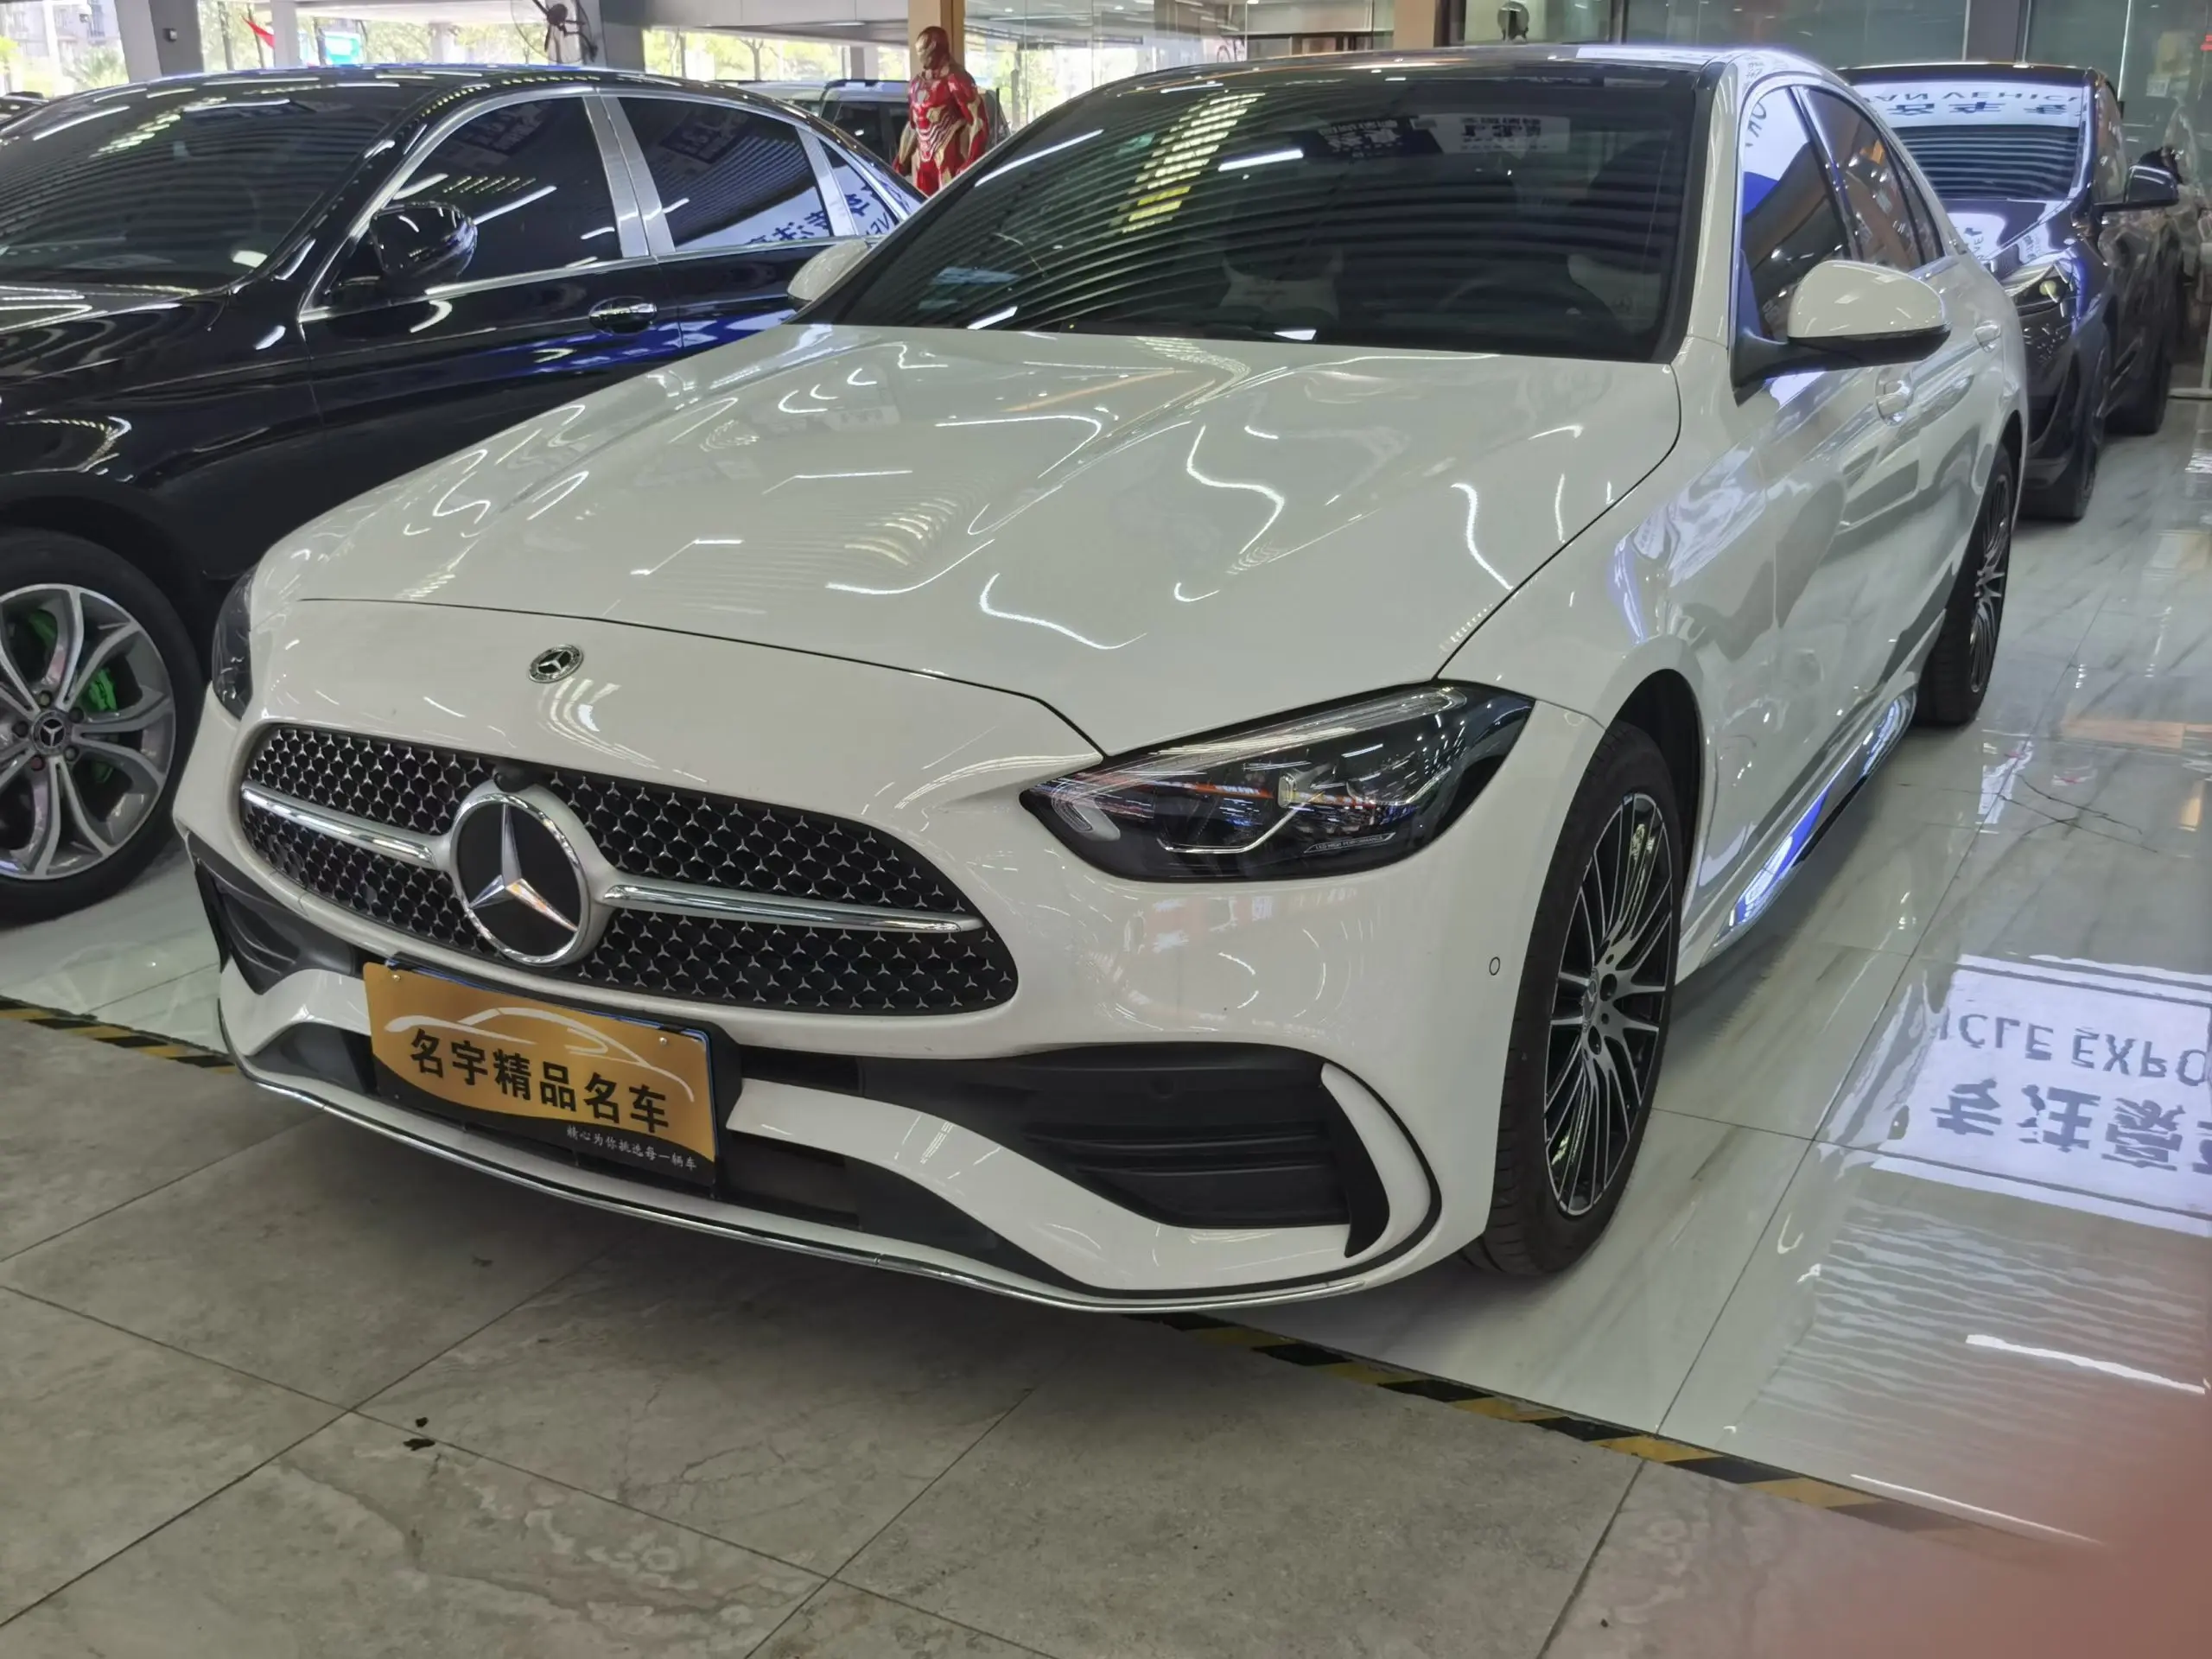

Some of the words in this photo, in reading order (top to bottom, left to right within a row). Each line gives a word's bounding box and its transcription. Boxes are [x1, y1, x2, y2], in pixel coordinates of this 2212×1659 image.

[410, 1027, 670, 1134] 名宇精品名车
